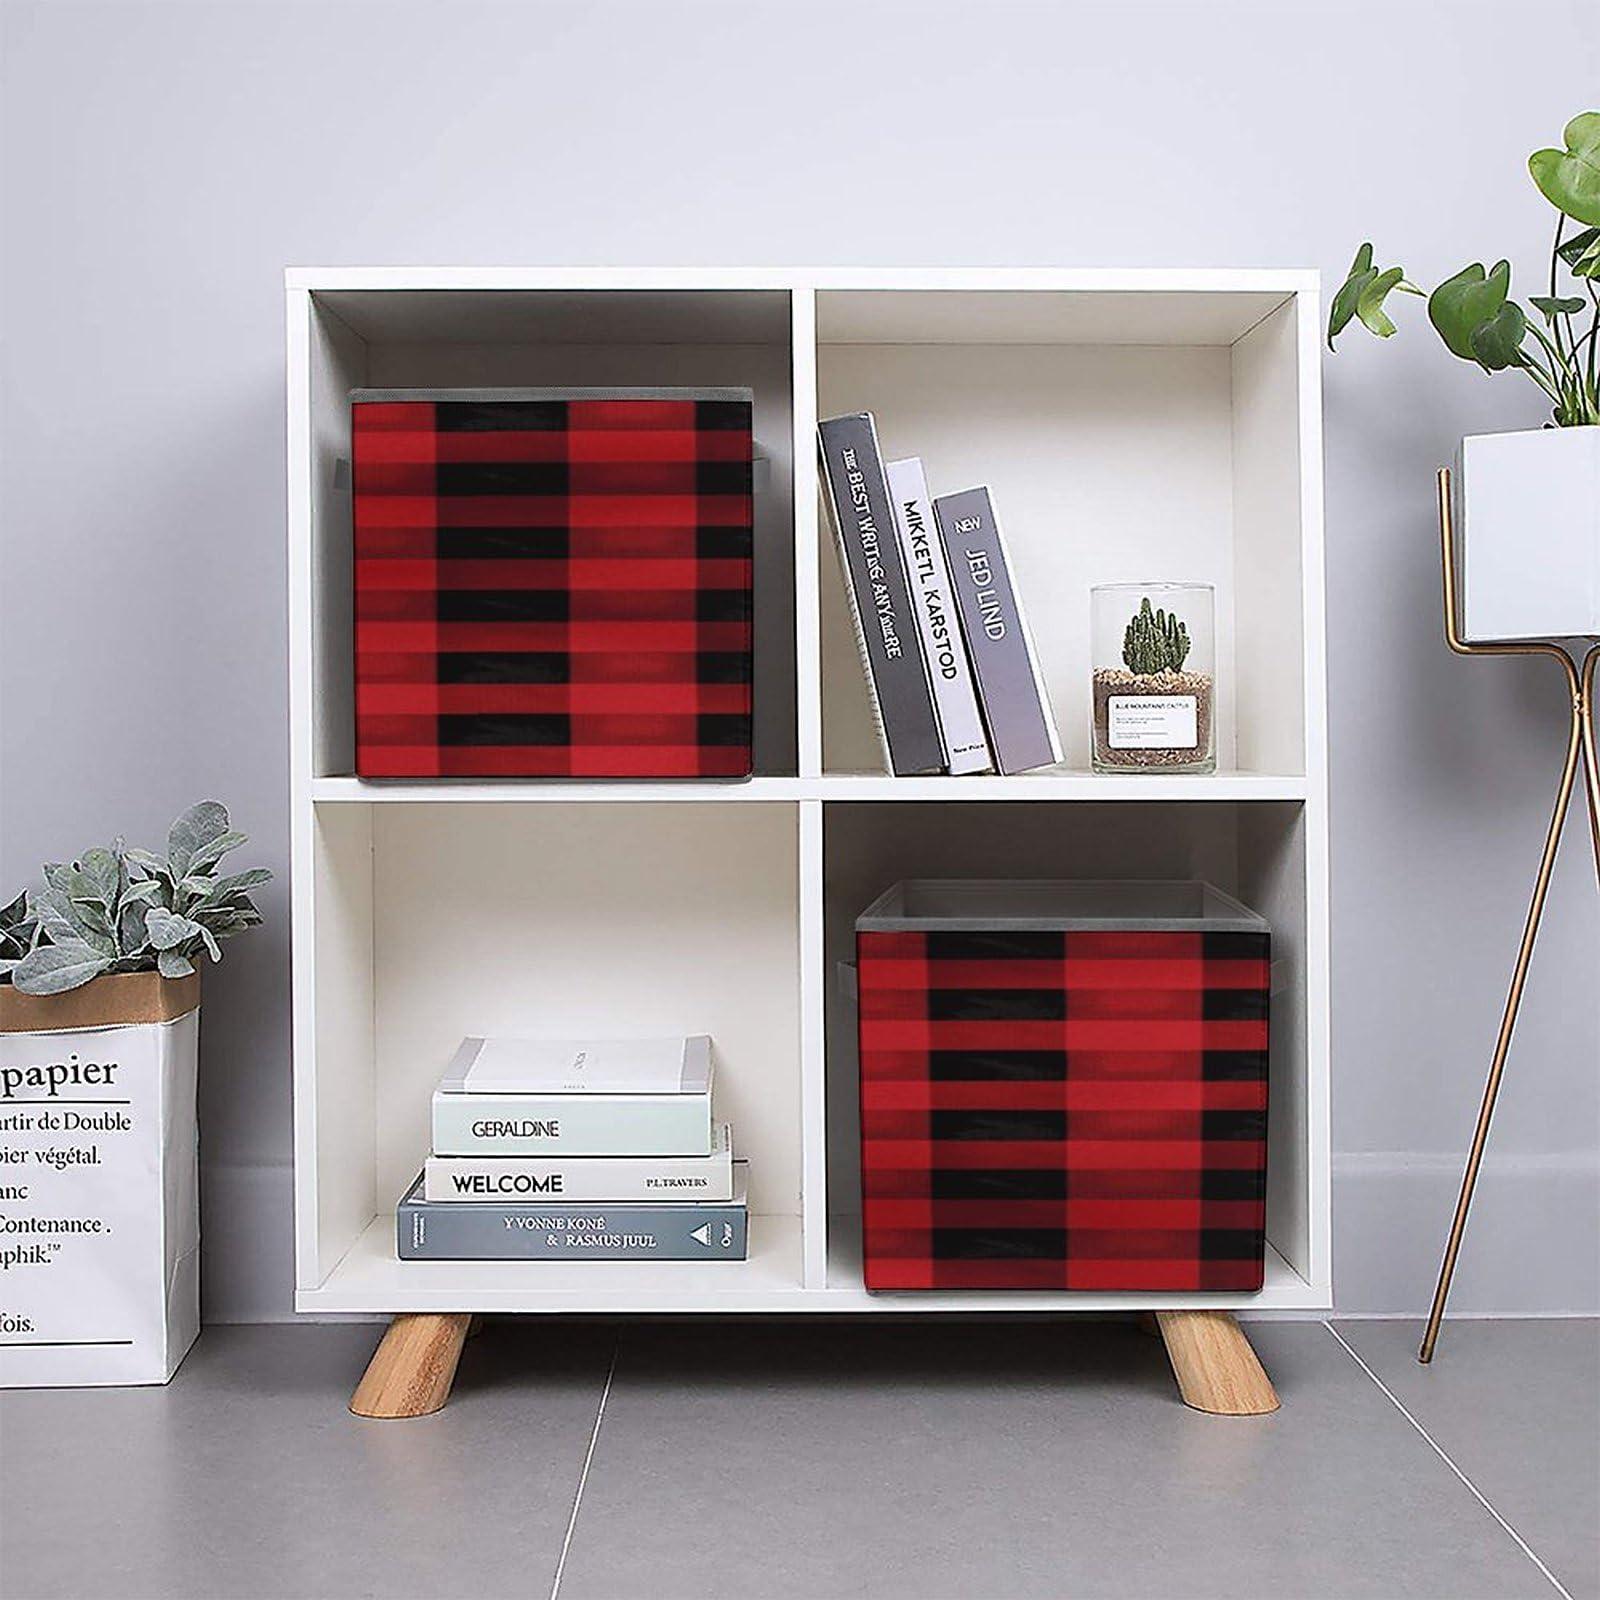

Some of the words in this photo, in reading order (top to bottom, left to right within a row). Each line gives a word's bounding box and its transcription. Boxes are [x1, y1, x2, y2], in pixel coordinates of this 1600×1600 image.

[849, 469, 870, 513] BEST
[955, 516, 981, 534] NEW
[965, 549, 993, 587] JED
[904, 500, 935, 584] MIKKETL
[924, 589, 957, 680] KARSTOD
[977, 589, 1006, 641] LIND
[0, 1054, 118, 1098] papier
[0, 1112, 34, 1131] rtir
[37, 1111, 60, 1131] de
[63, 1111, 131, 1131] Double
[471, 1120, 560, 1138] GERALDINE
[35, 1145, 102, 1170] végétal.
[452, 1174, 564, 1194] WELCOME
[546, 1233, 559, 1247] &
[566, 1233, 621, 1248] RASMUS
[621, 1233, 658, 1249] JUUL
